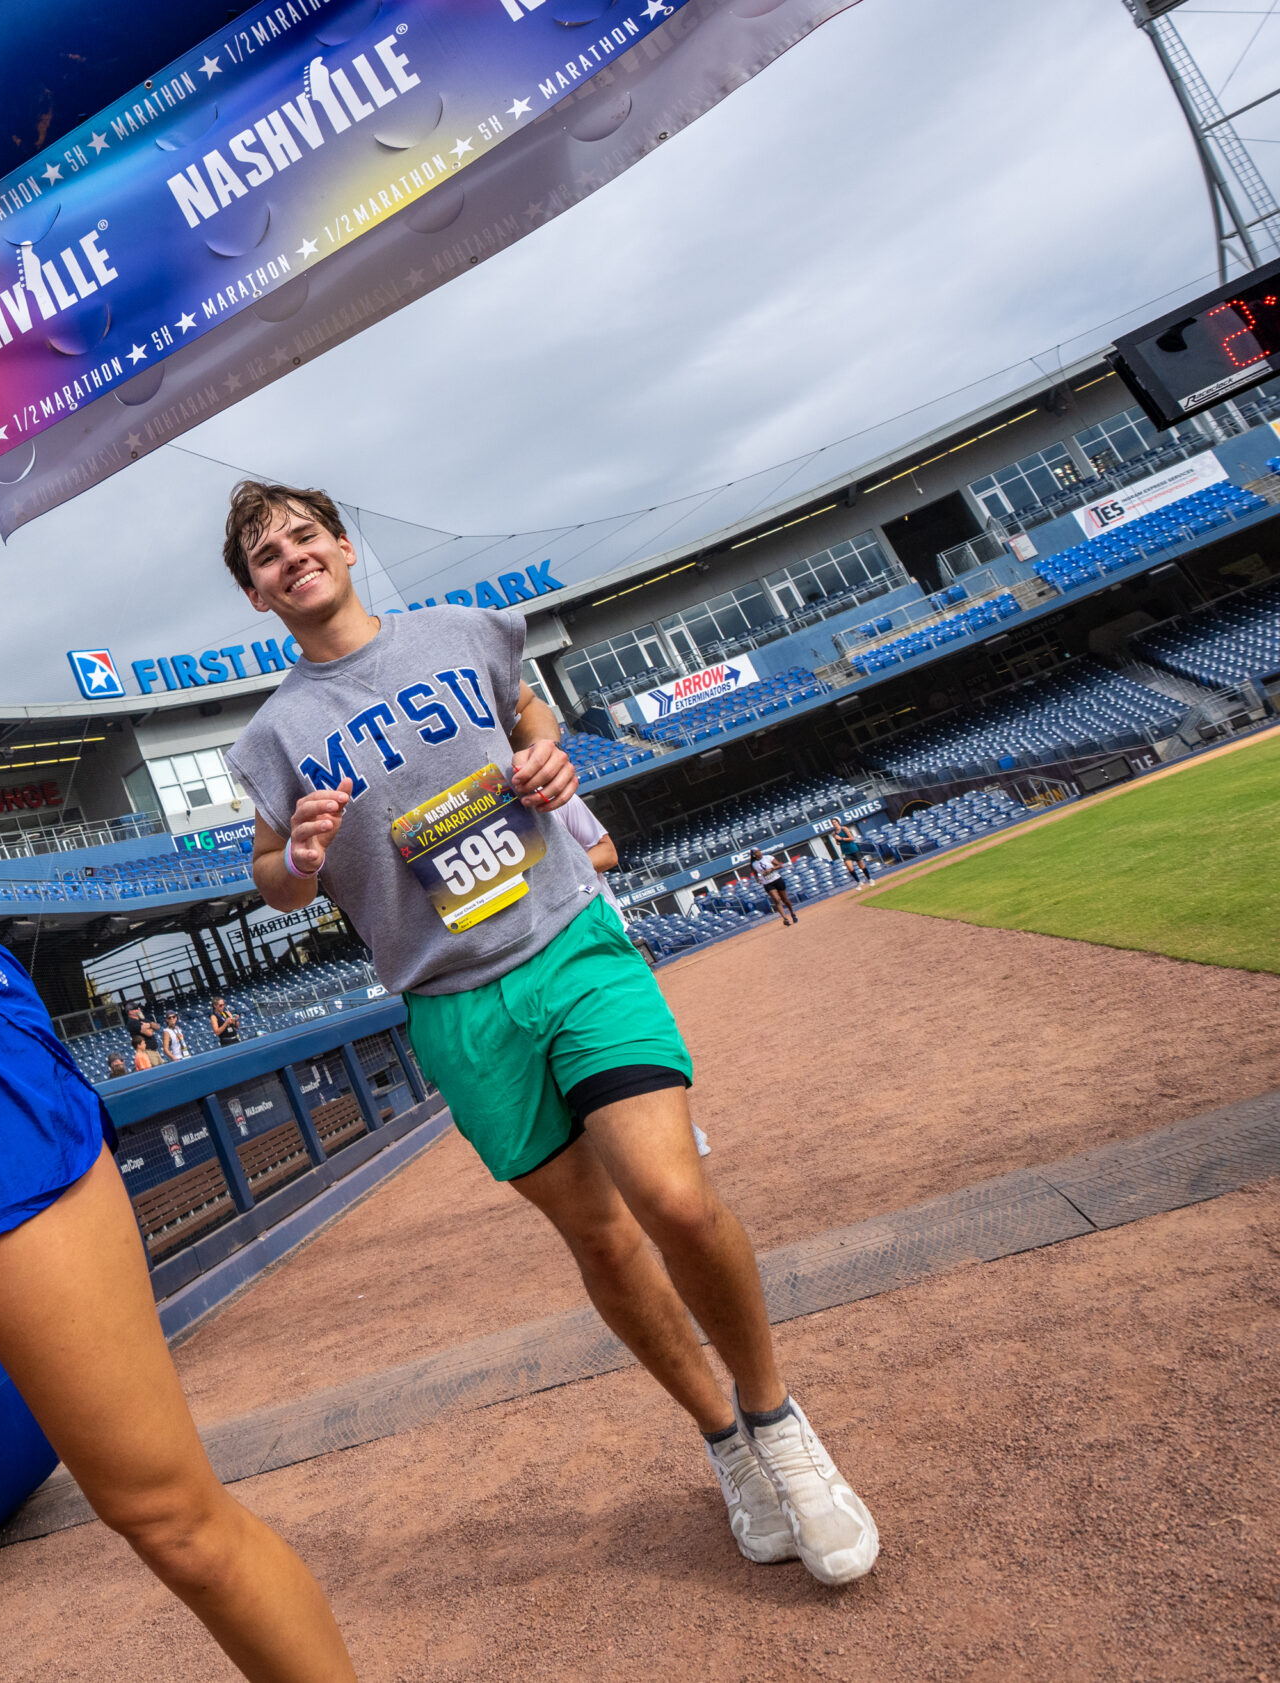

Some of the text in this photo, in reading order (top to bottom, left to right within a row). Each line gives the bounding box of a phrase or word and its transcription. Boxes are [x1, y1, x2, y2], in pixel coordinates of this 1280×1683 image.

[110, 71, 198, 141] MARATHON
[201, 254, 292, 319] MARATHON
[537, 17, 640, 99] MARATHON
[1090, 502, 1125, 528] IES
[131, 645, 248, 694] FIRST
[445, 558, 568, 611] PARK
[674, 664, 725, 701] ARROW
[675, 682, 732, 711] EXTERMINATORS
[298, 667, 496, 803] MTSU
[416, 793, 497, 848] 1/2 MARATHON
[843, 800, 883, 821] SUITES
[431, 817, 526, 896] 595
